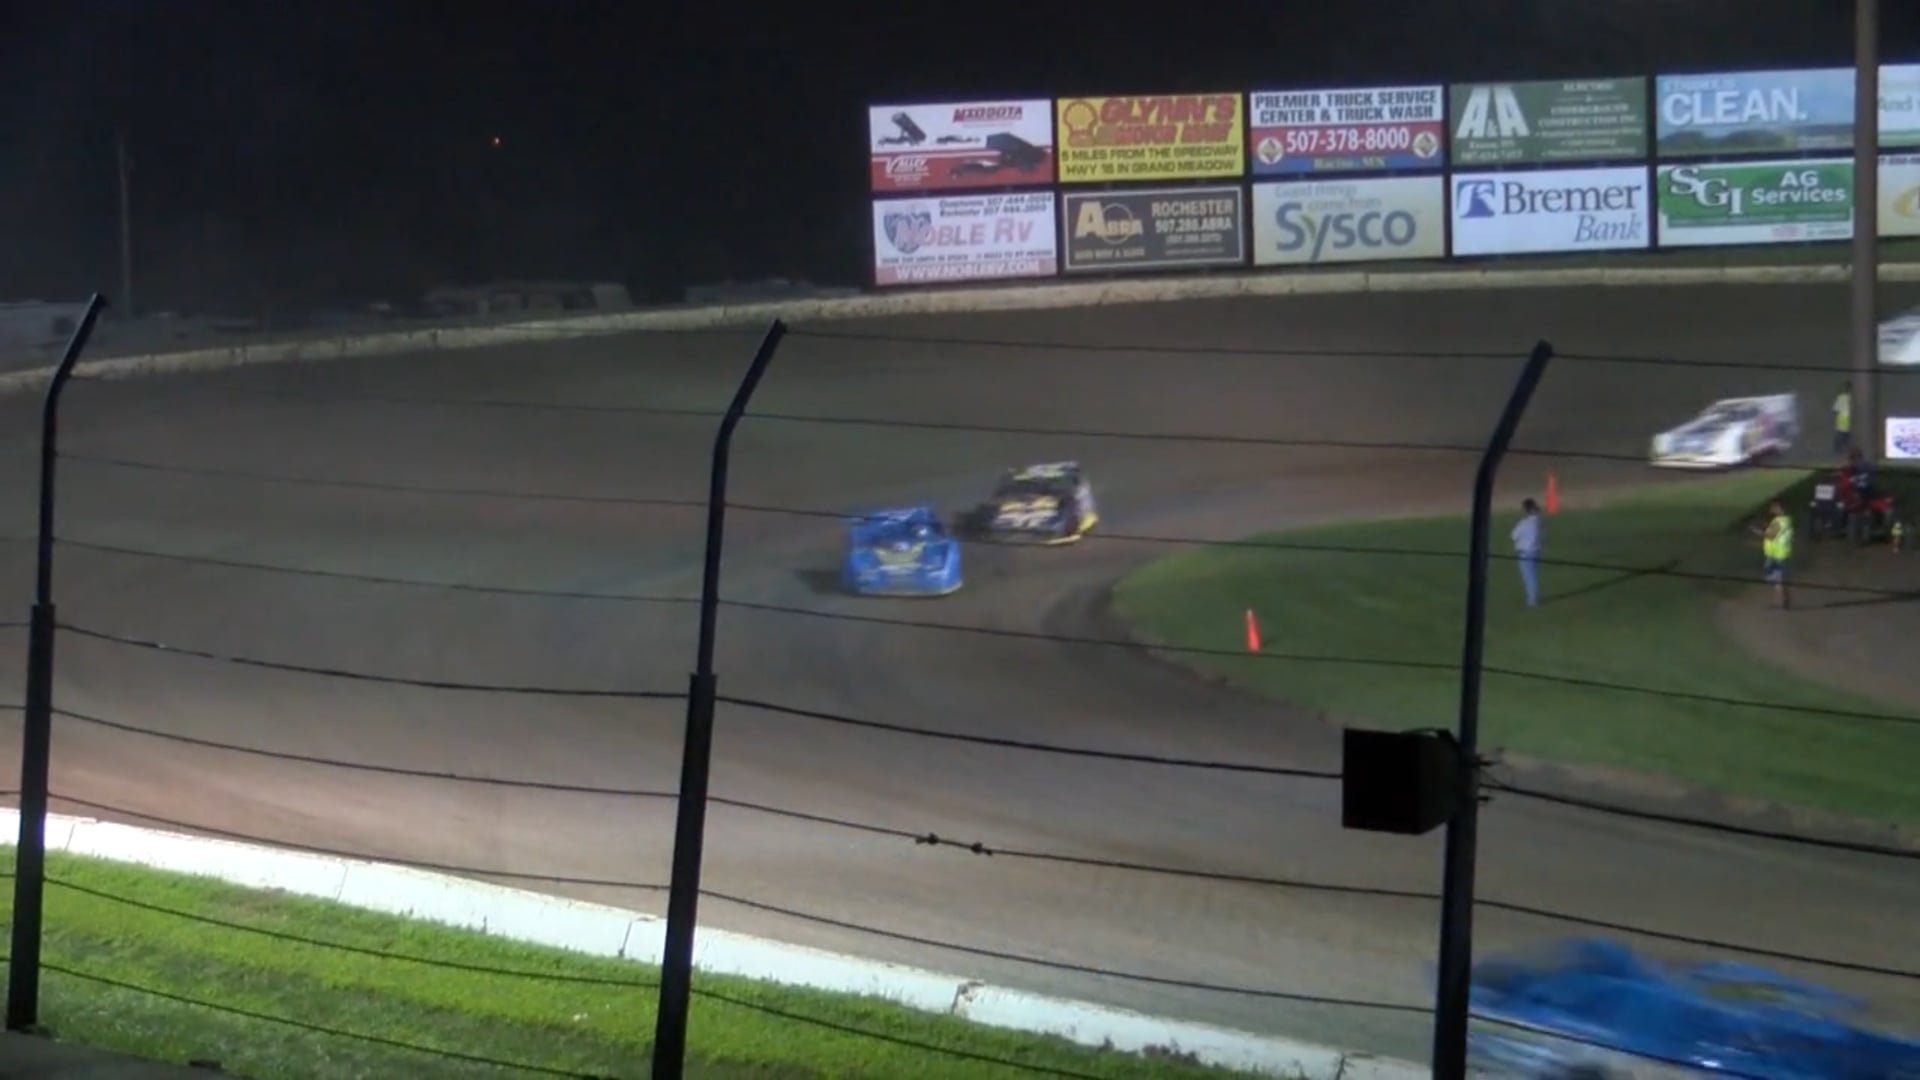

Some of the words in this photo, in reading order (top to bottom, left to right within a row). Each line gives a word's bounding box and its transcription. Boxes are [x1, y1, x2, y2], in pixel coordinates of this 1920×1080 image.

[1255, 93, 1321, 109] PREMIER
[1326, 92, 1373, 107] TRUCK
[1378, 90, 1437, 105] SERVICE
[1663, 88, 1807, 125] CLEAN.
[1260, 108, 1316, 123] CENTER
[1320, 108, 1330, 121] &
[1338, 106, 1383, 121] TRUCK
[1389, 105, 1433, 119] WASH
[1286, 127, 1409, 153] 507-378-8000
[1072, 149, 1107, 161] MILES
[1110, 147, 1145, 160] FROM
[1148, 146, 1171, 158] THE
[1173, 144, 1239, 157] SPEEDWAY
[1066, 164, 1097, 176] HWY
[1117, 162, 1130, 173] IN
[1131, 161, 1175, 173] GRAND
[1177, 159, 1236, 171] MEADOW
[1781, 171, 1819, 187] AG
[1501, 182, 1643, 215] Bremer
[1670, 166, 1743, 215] SGI
[1751, 186, 1846, 205] Services
[1151, 199, 1234, 217] ROCHESTER
[1275, 202, 1416, 262] Sysco
[1573, 213, 1643, 244] Bank
